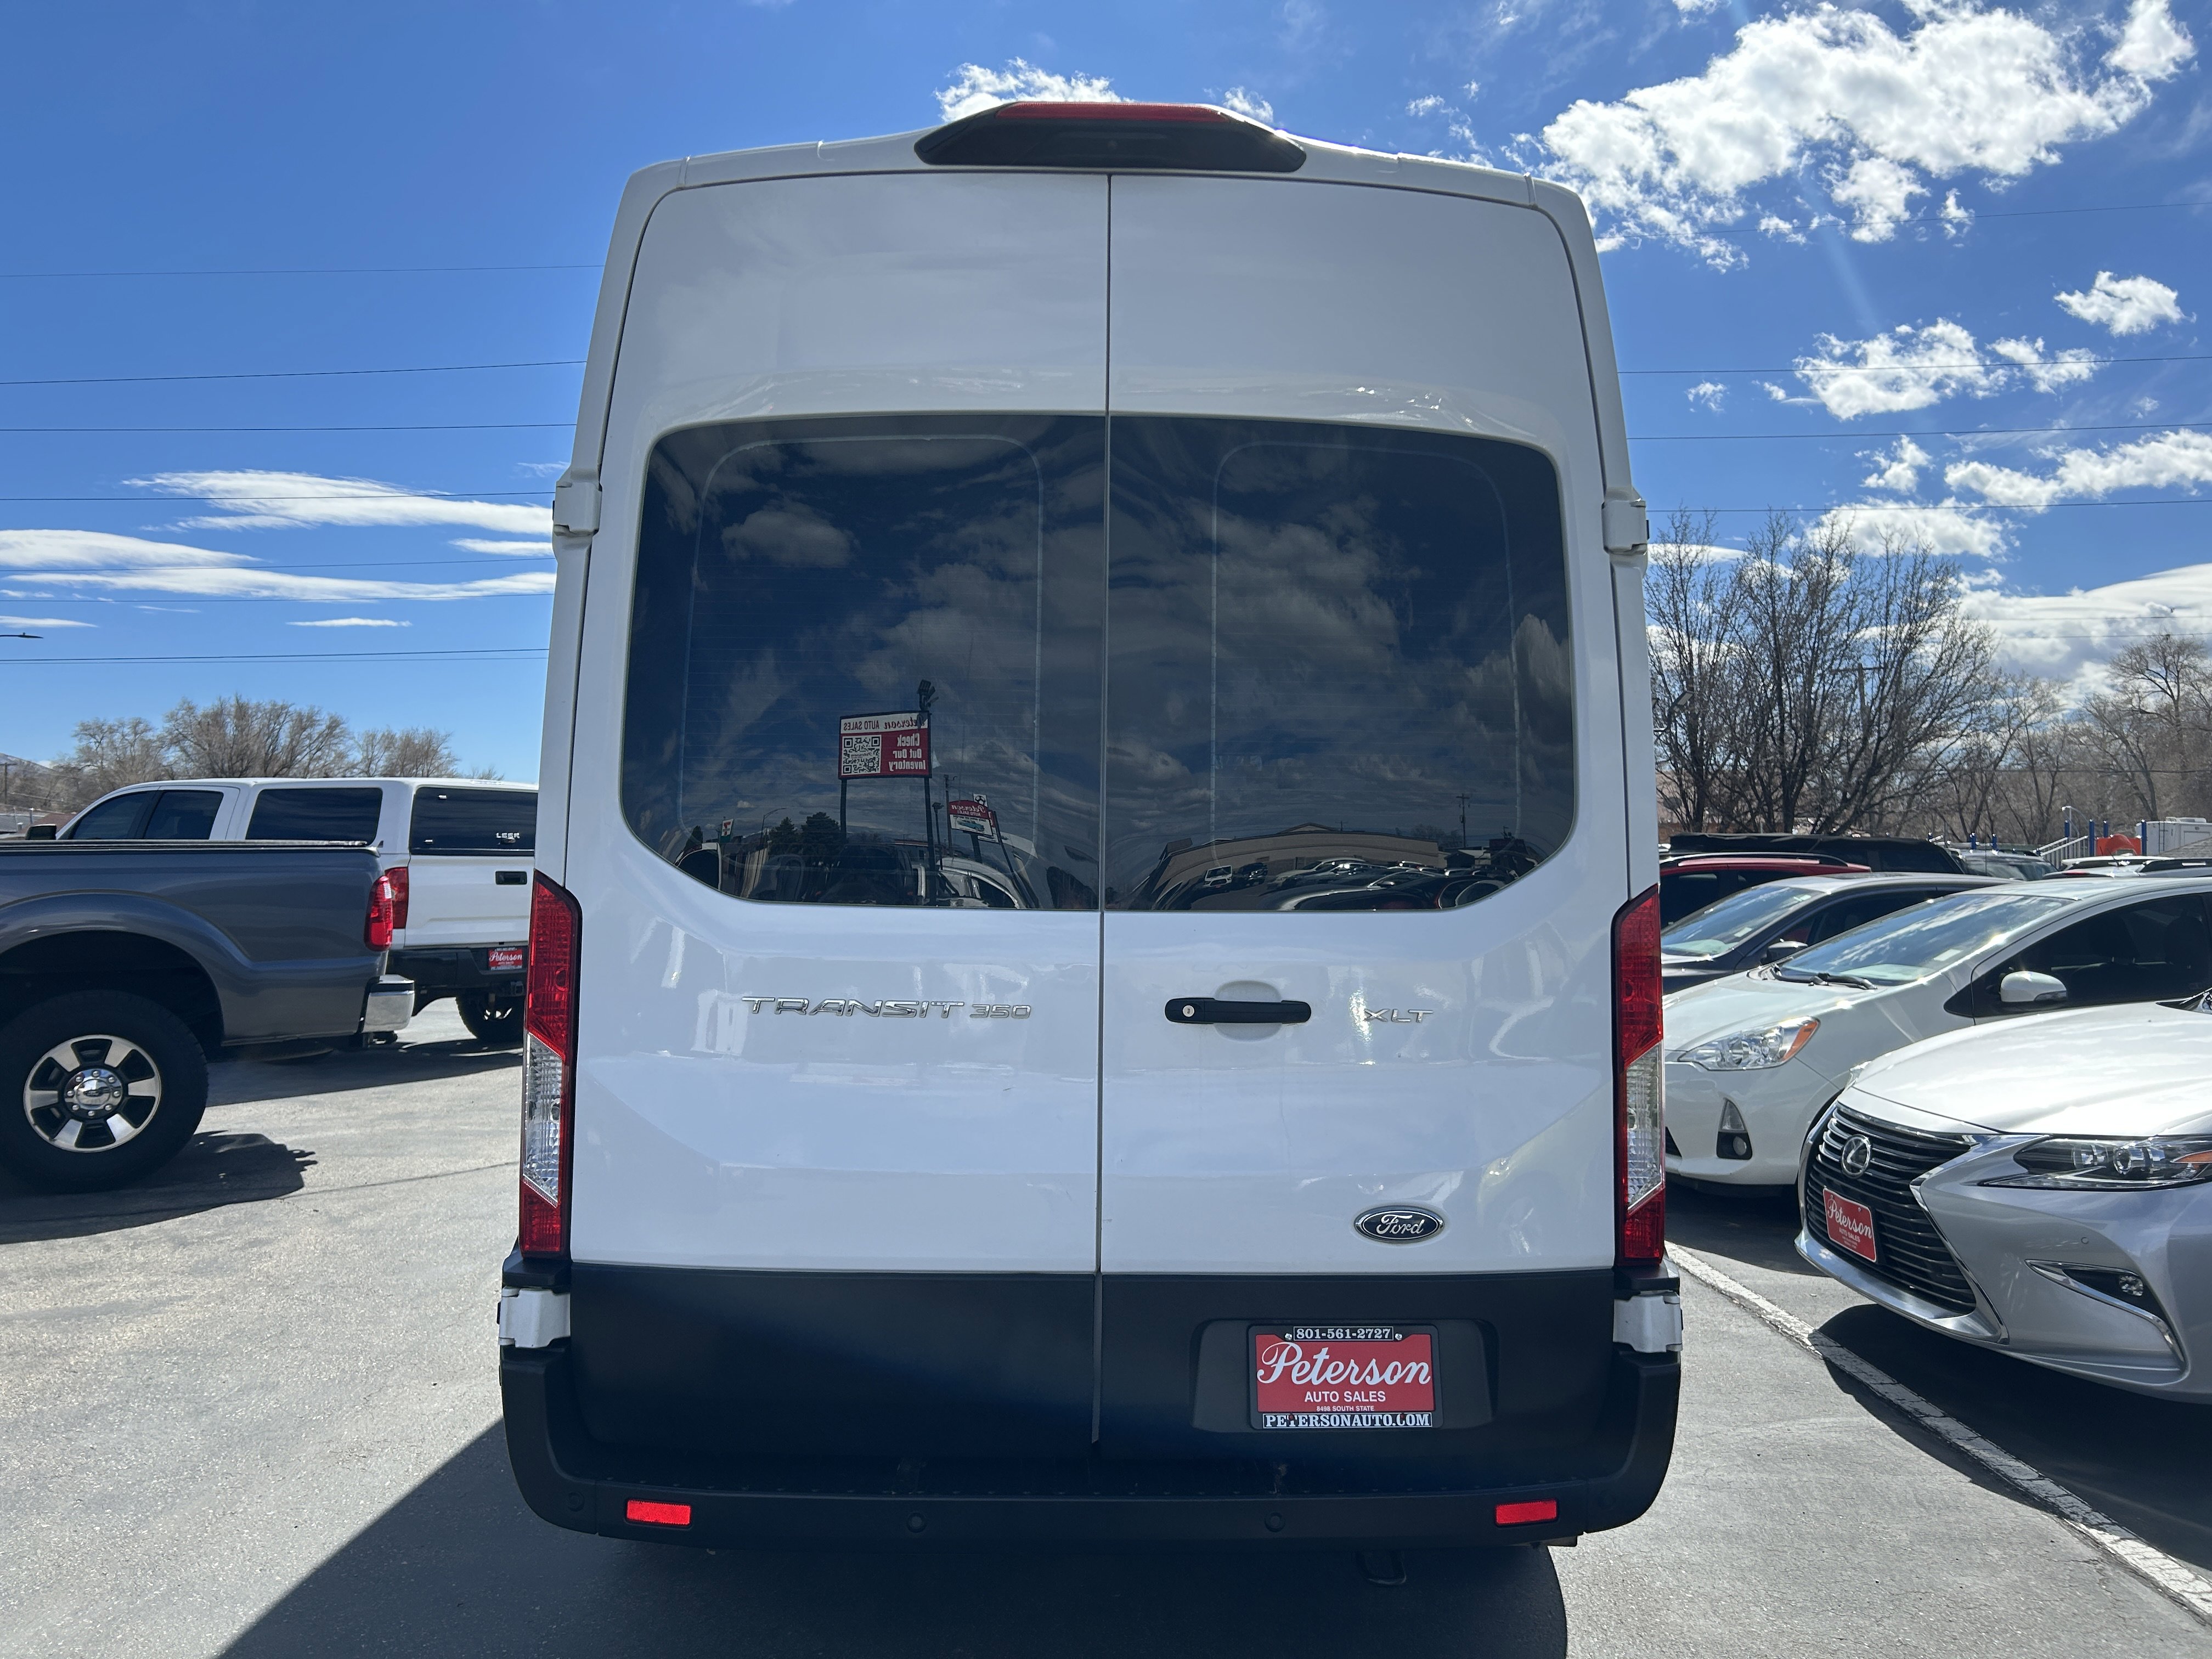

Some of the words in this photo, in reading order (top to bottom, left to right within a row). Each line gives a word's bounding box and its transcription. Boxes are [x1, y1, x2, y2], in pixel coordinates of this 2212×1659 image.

[489, 951, 522, 962] Peterson
[742, 996, 964, 1019] TRANSIT
[969, 1004, 1032, 1019] 350
[1363, 1008, 1434, 1023] XLT
[1376, 1214, 1425, 1235] Ford
[1827, 1198, 1872, 1239] Peterson
[1296, 1328, 1391, 1339] 801-561-2727
[1257, 1342, 1431, 1385] Peterson
[1304, 1391, 1339, 1402] AUTO
[1344, 1391, 1386, 1402] SALES
[1265, 1414, 1430, 1427] PETERSONAUTO.COM
